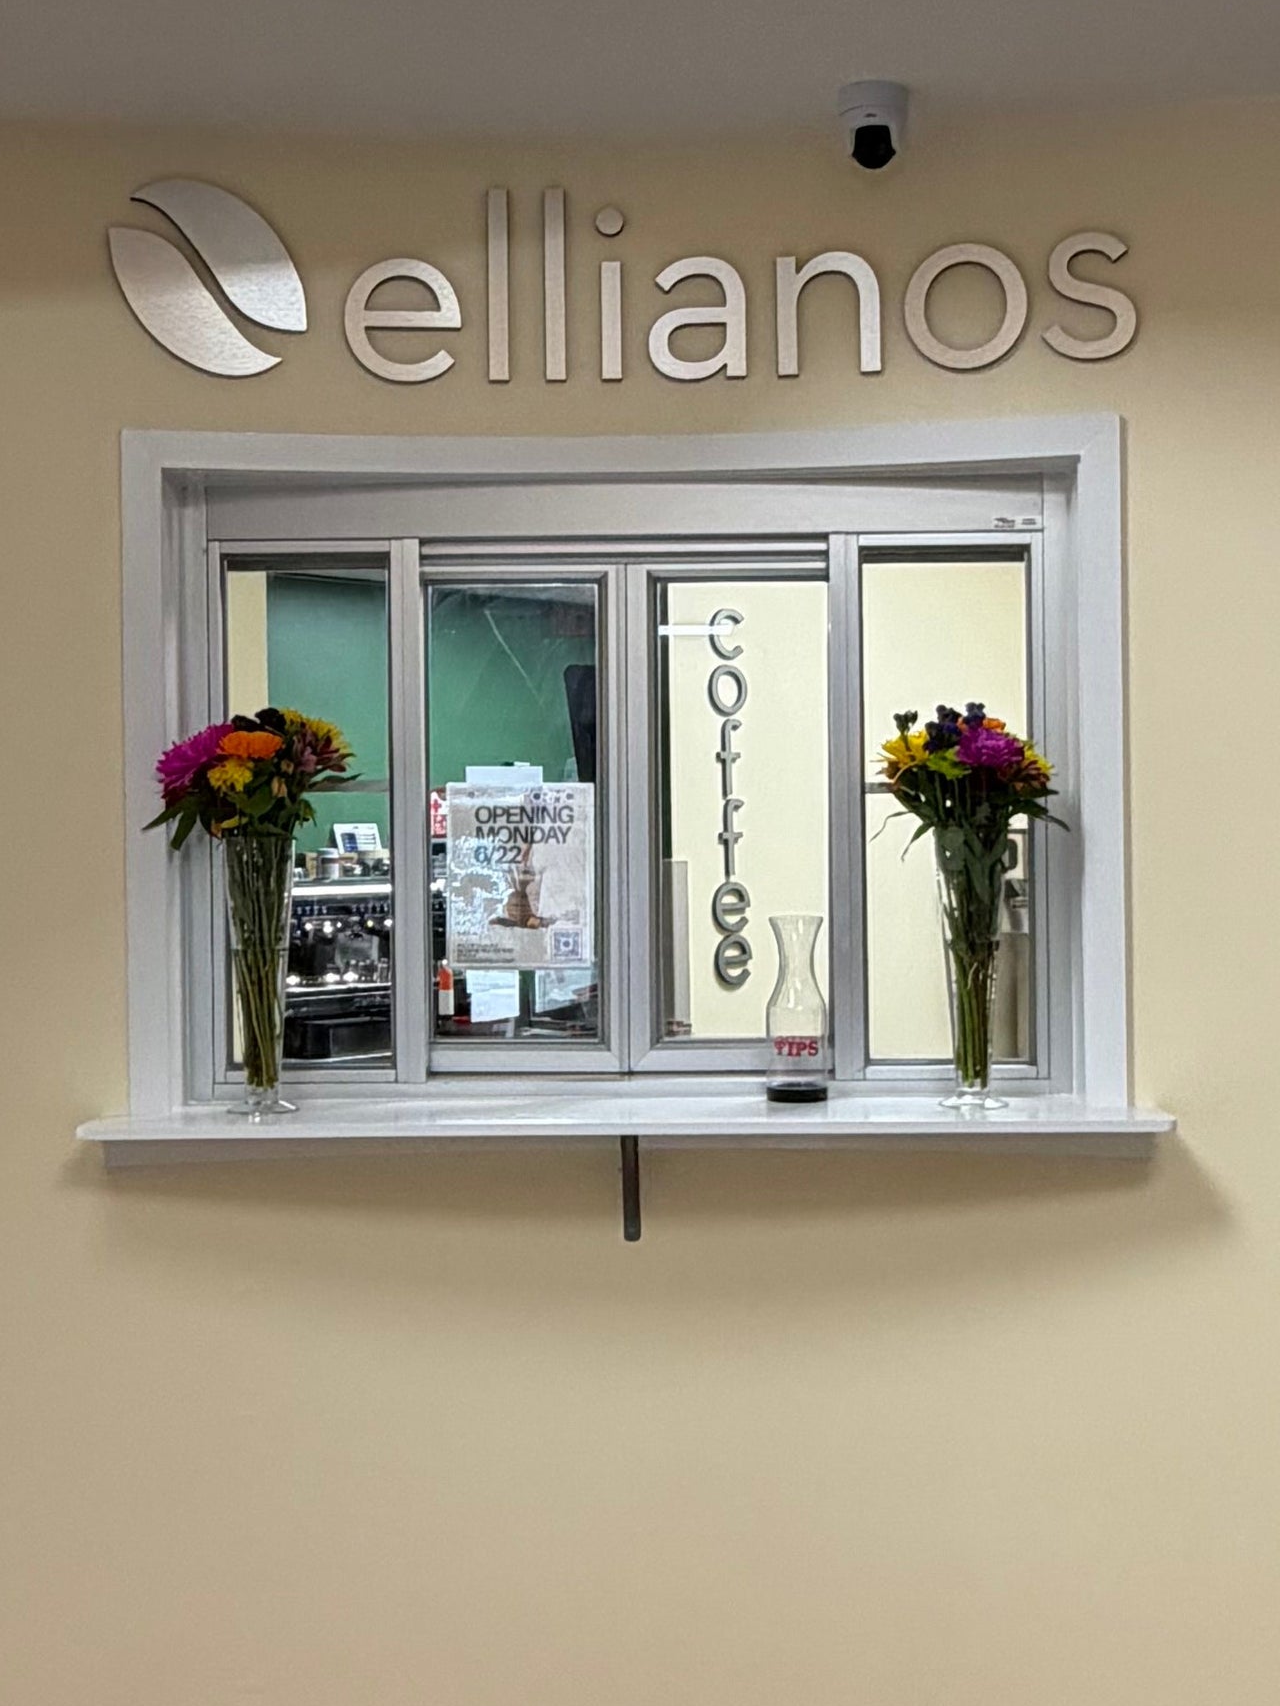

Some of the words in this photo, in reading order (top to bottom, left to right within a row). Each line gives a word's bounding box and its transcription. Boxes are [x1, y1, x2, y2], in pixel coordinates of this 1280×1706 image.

[344, 187, 1138, 384] ellianos
[707, 607, 753, 991] coffee
[474, 805, 574, 824] OPENING
[475, 825, 572, 844] MONDAY
[474, 845, 521, 865] 6/22
[774, 1036, 819, 1057] TIPS
